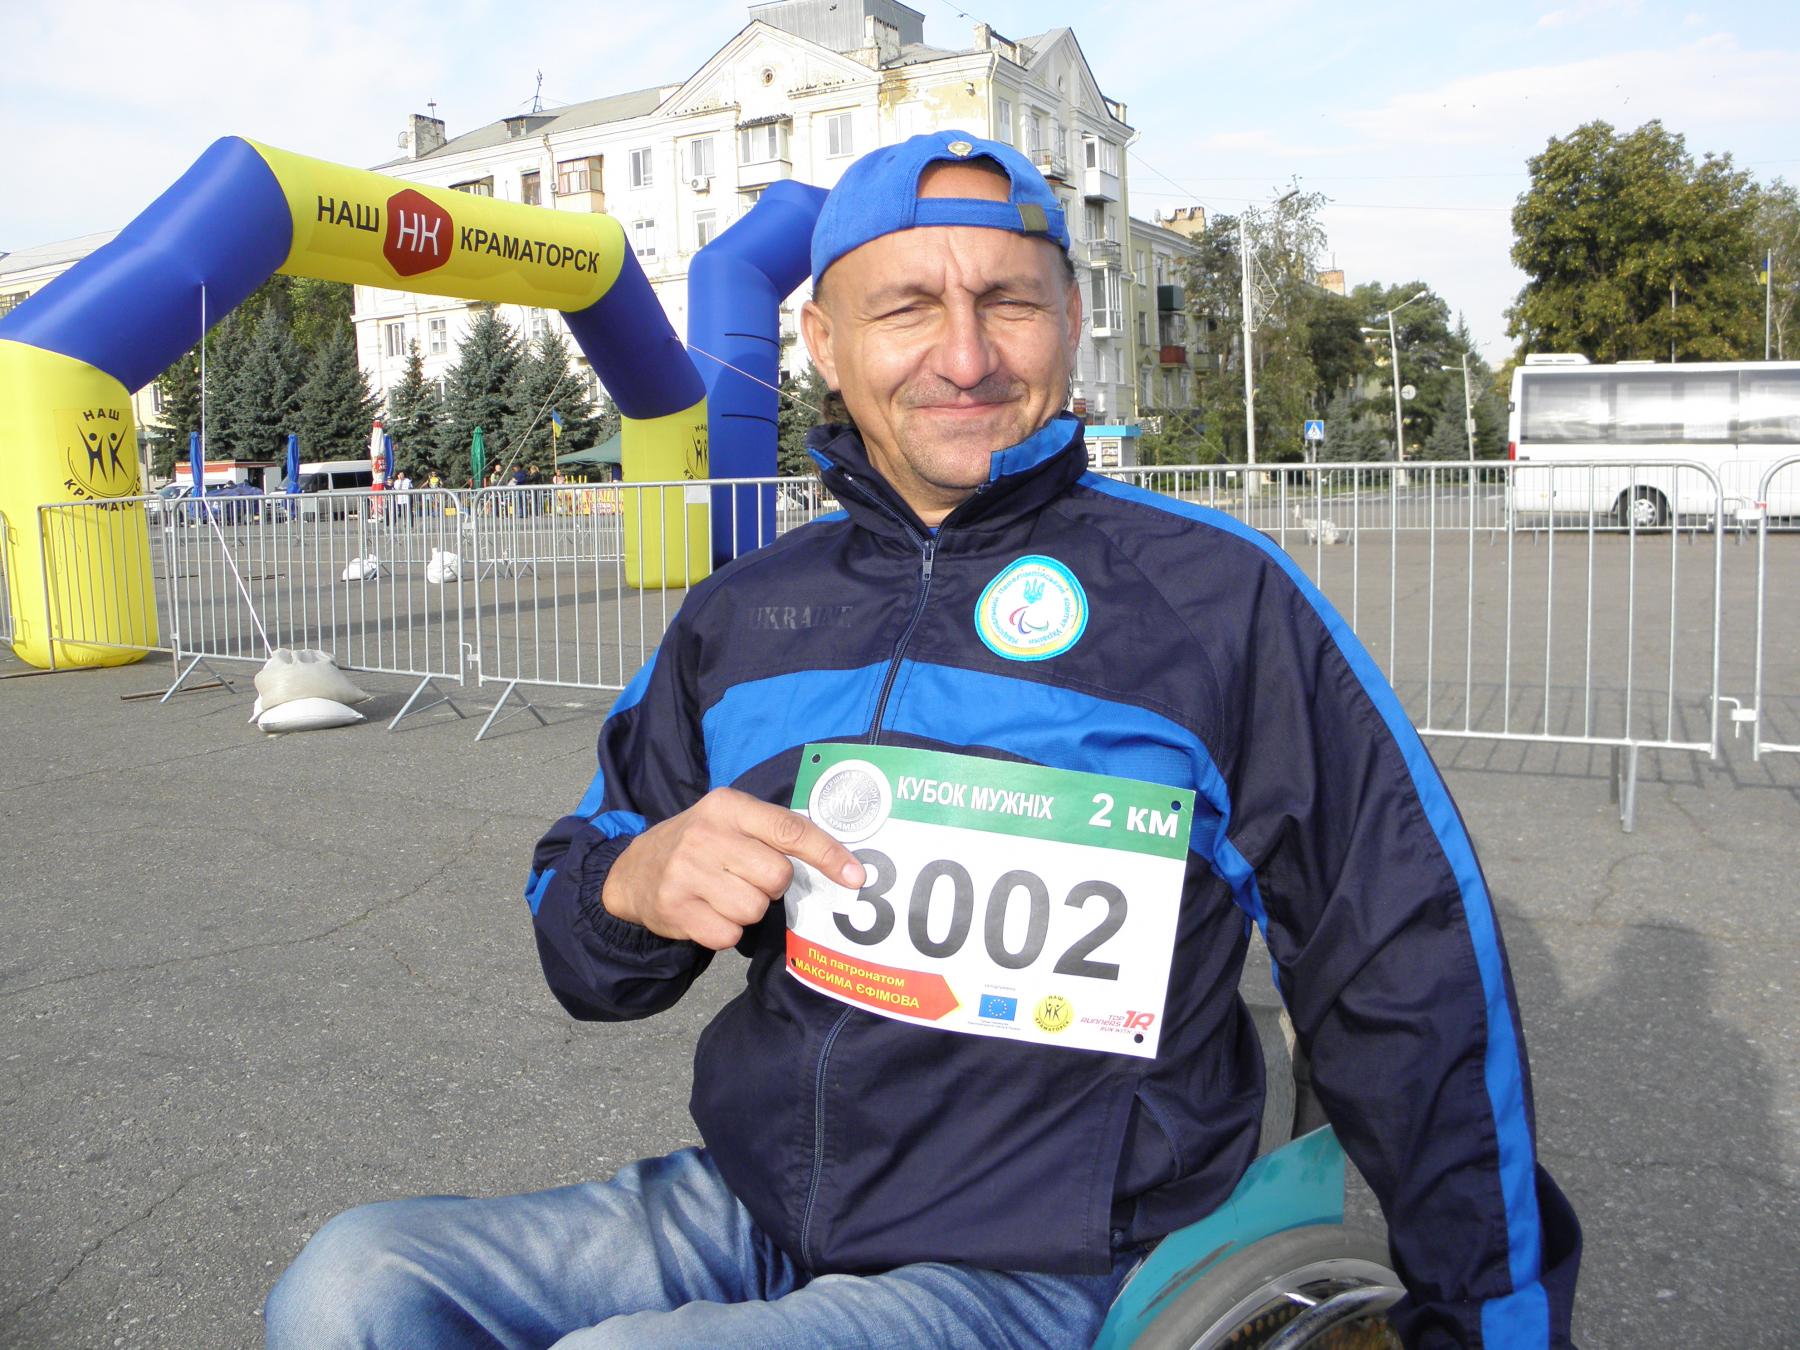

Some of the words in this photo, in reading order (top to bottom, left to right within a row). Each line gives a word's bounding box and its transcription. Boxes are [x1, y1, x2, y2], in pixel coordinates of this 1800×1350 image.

[317, 196, 379, 232] НАШ
[397, 209, 441, 255] НК
[460, 226, 600, 273] КРАМАТОРСК
[83, 408, 120, 421] НАШ
[896, 776, 968, 808] КУБОК
[970, 785, 1055, 820] МУЖНІХ
[1088, 793, 1114, 828] 2
[832, 849, 1128, 981] 3002
[795, 957, 853, 990] МАКСИМА
[856, 983, 920, 1008] ЄФІМОВА
[808, 947, 828, 965] Під
[830, 960, 905, 987] патронатом
